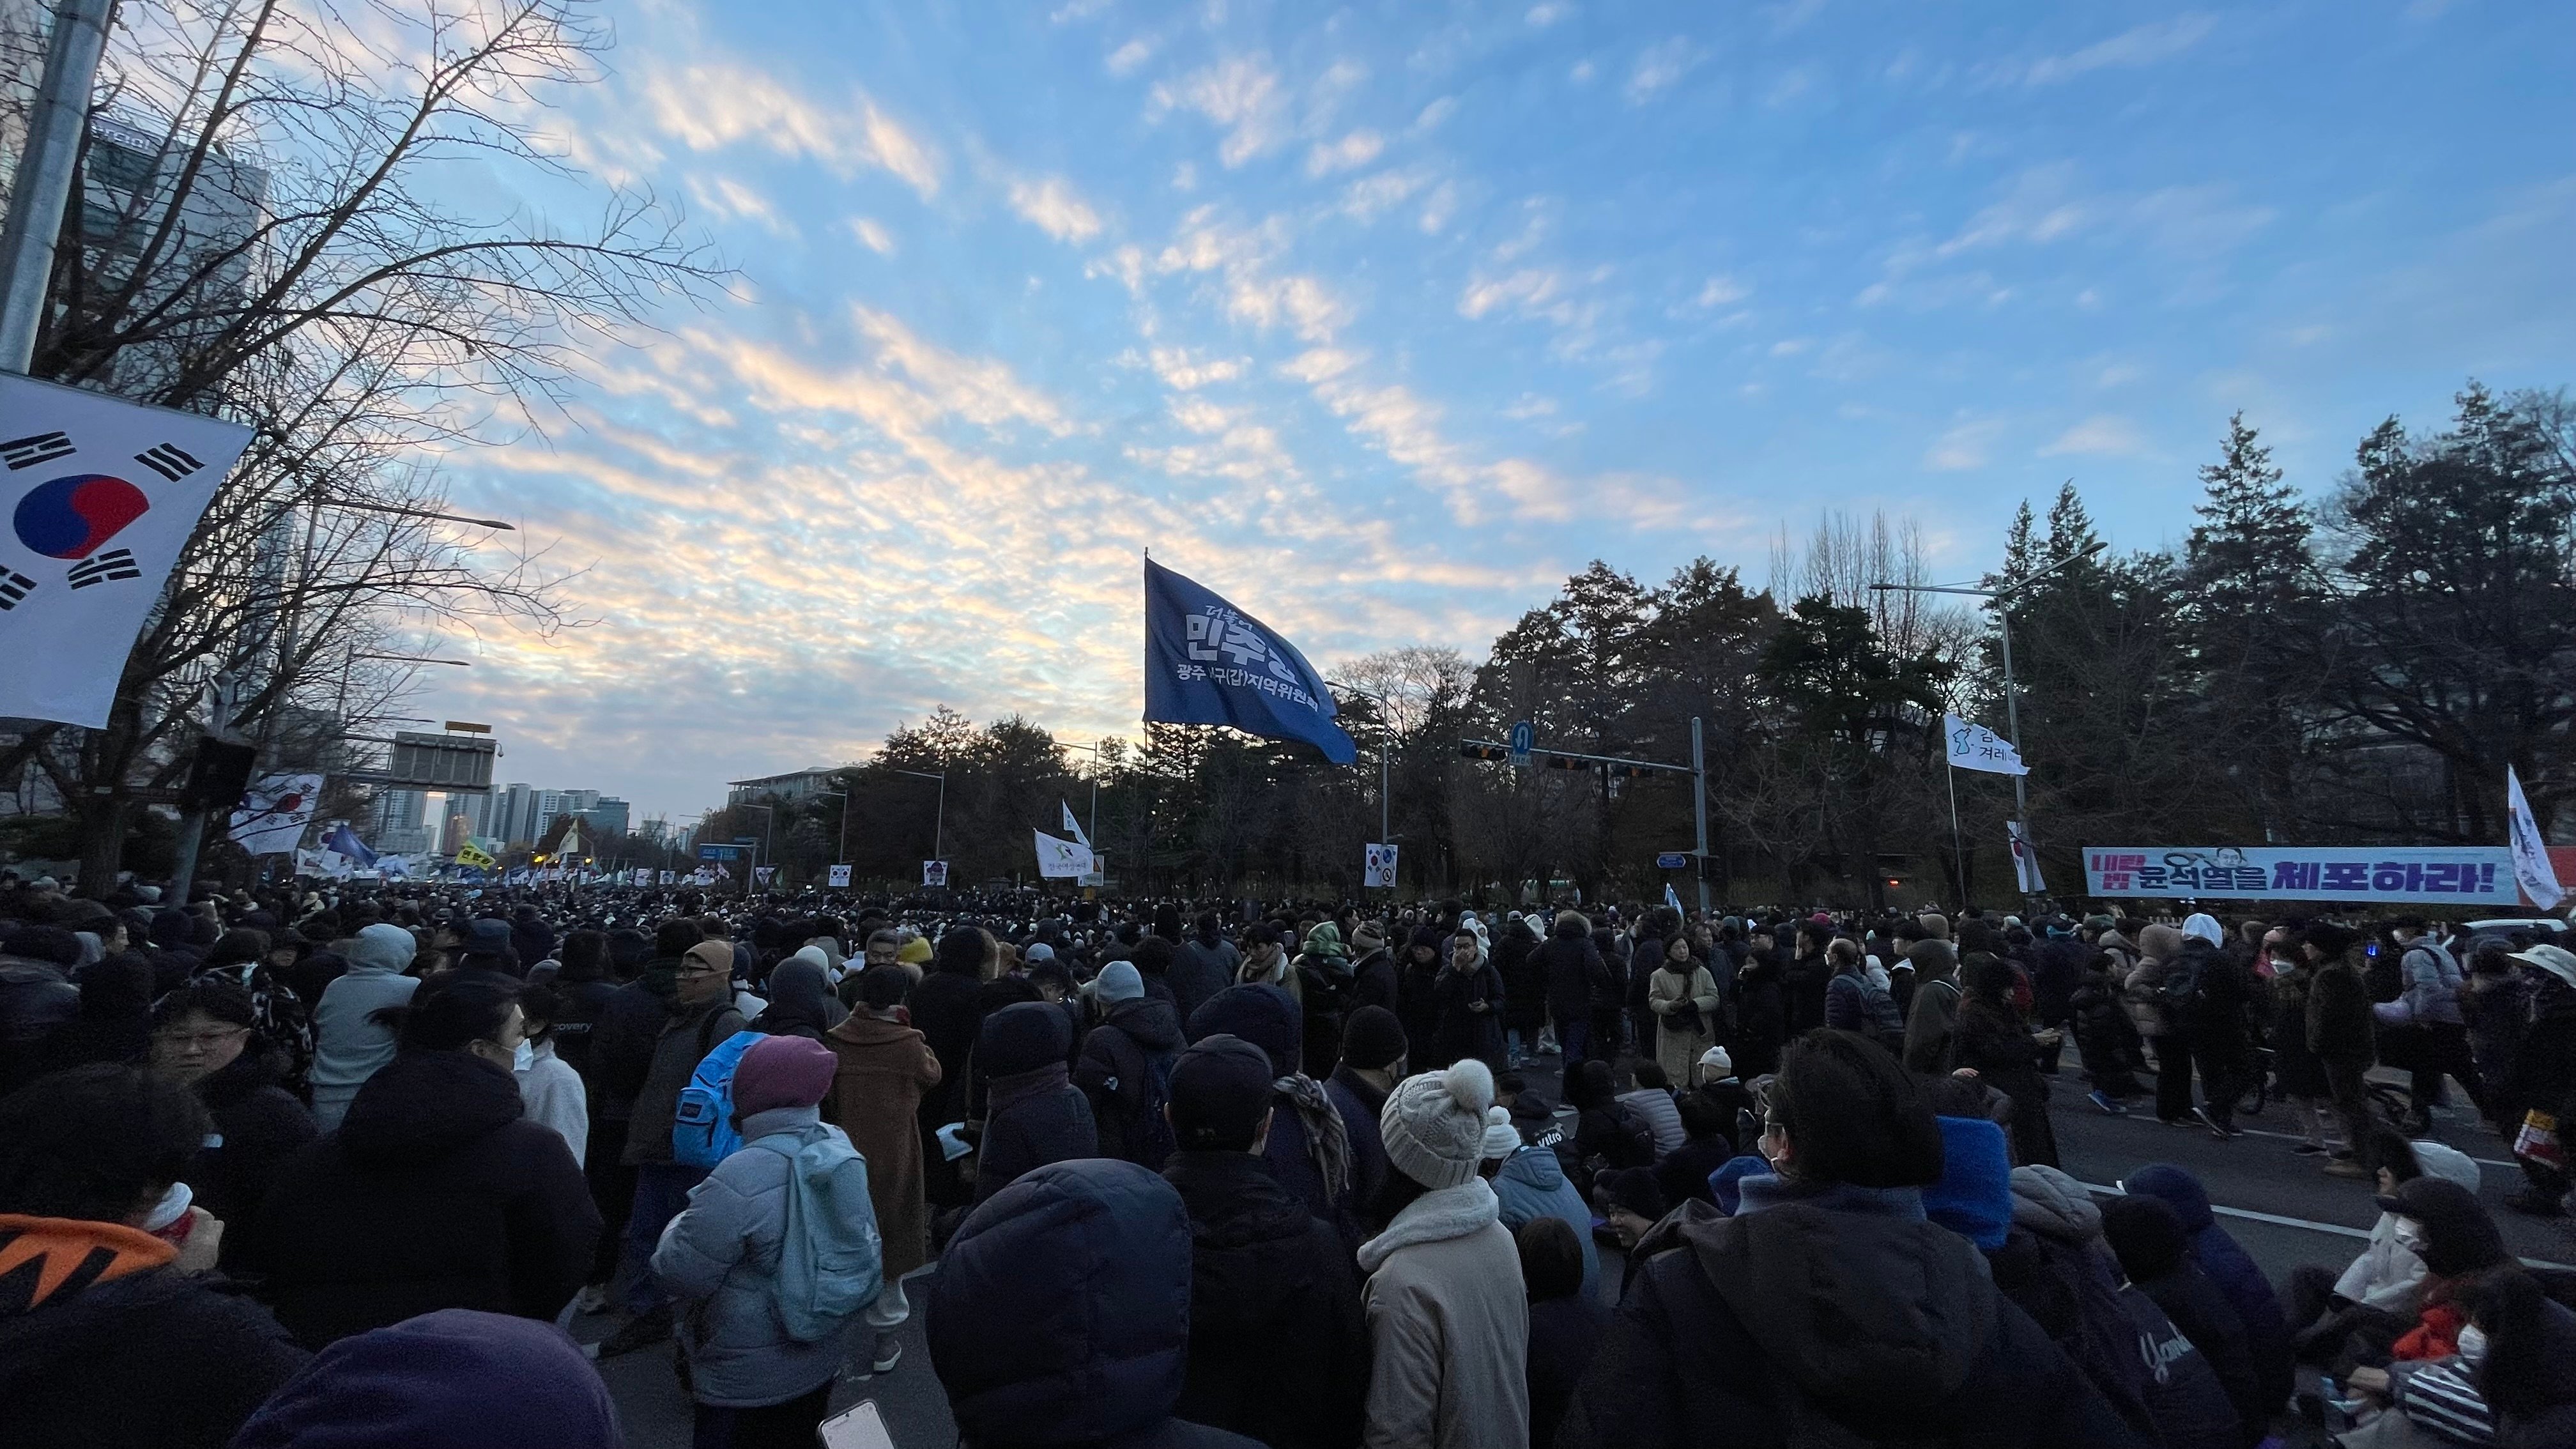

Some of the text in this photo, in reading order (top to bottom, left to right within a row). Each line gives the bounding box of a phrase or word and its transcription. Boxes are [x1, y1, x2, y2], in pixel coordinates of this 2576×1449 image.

[2139, 861, 2495, 893] 윤석열을 체포하라!
[551, 1022, 593, 1033] covery
